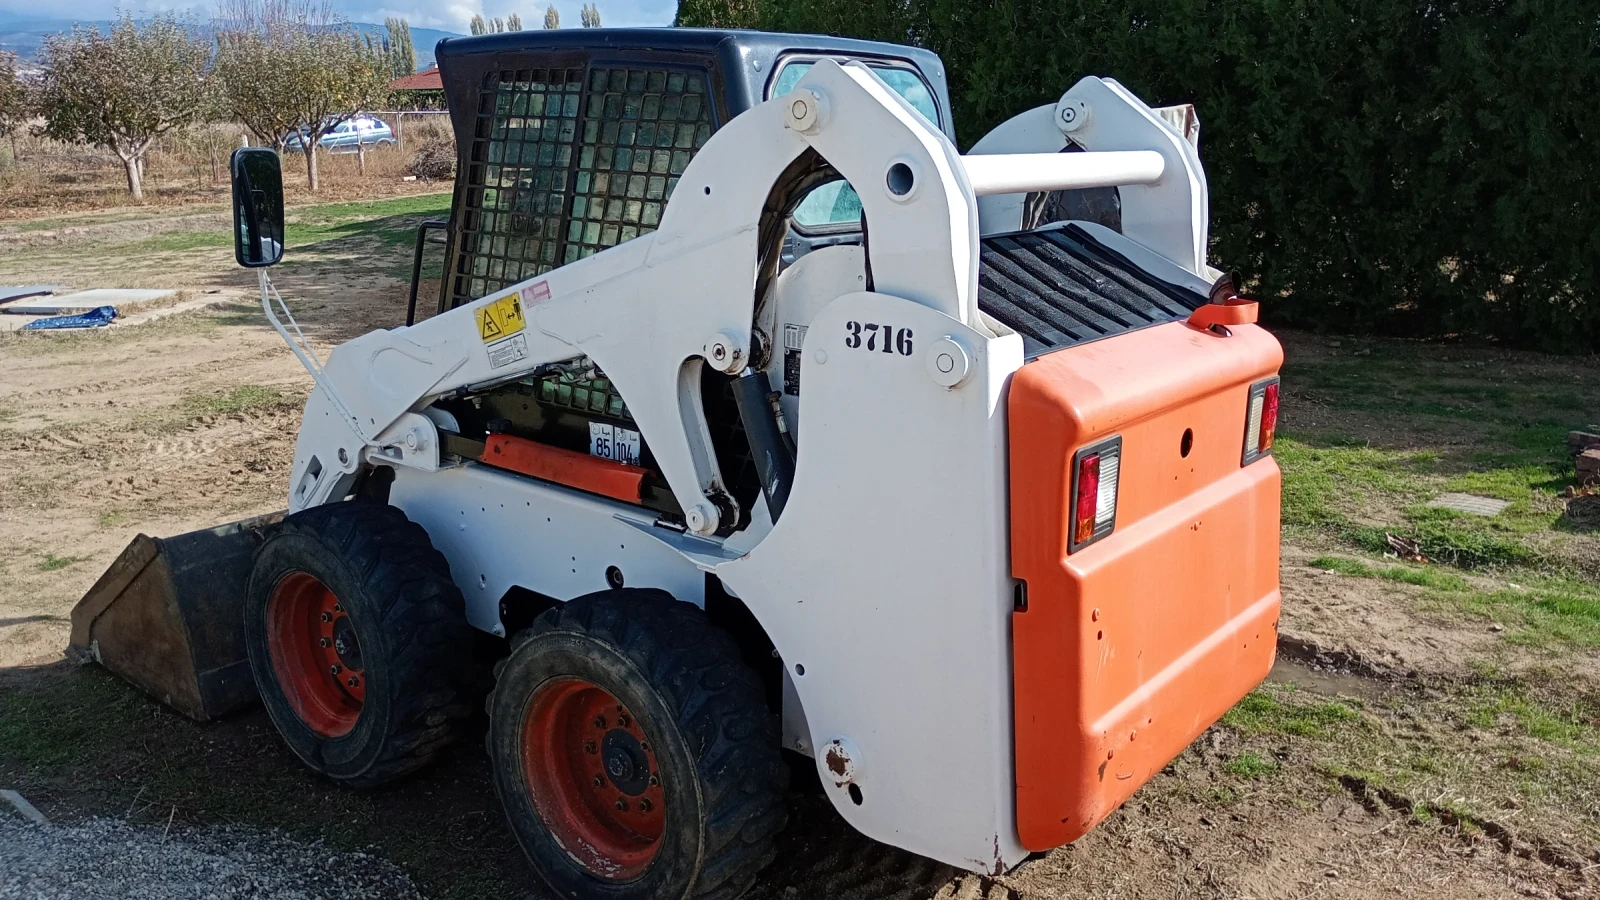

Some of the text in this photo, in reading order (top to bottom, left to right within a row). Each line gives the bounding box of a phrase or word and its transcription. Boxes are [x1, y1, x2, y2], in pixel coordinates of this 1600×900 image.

[845, 320, 913, 356] 3716
[596, 437, 611, 458] 85
[616, 442, 633, 464] 104
